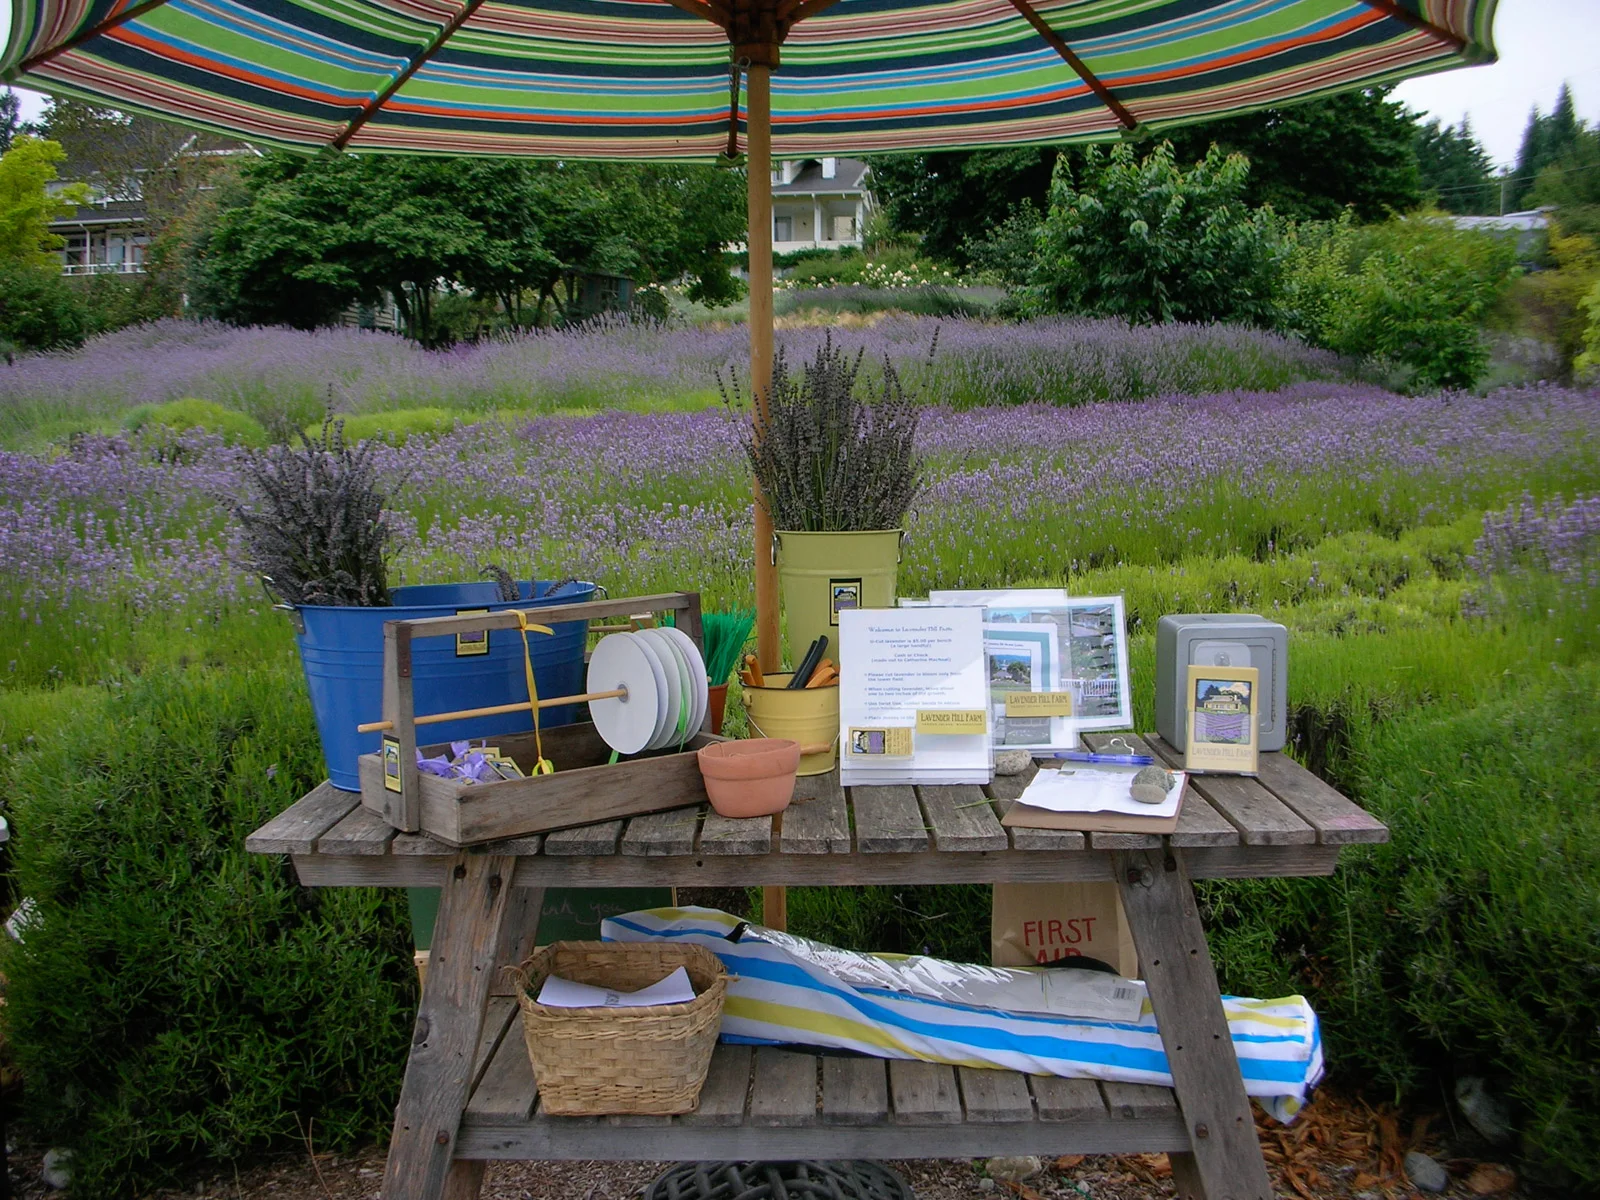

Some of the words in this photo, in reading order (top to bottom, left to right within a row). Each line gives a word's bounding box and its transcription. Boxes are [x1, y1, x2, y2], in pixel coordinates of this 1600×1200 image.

[1010, 694, 1038, 704] LAVENDER
[1038, 694, 1050, 704] HILL
[1051, 694, 1068, 704] FARM
[920, 713, 950, 722] LAVENDER
[951, 713, 964, 722] HILL
[965, 712, 983, 722] FARM
[1023, 917, 1097, 947] FIRST
